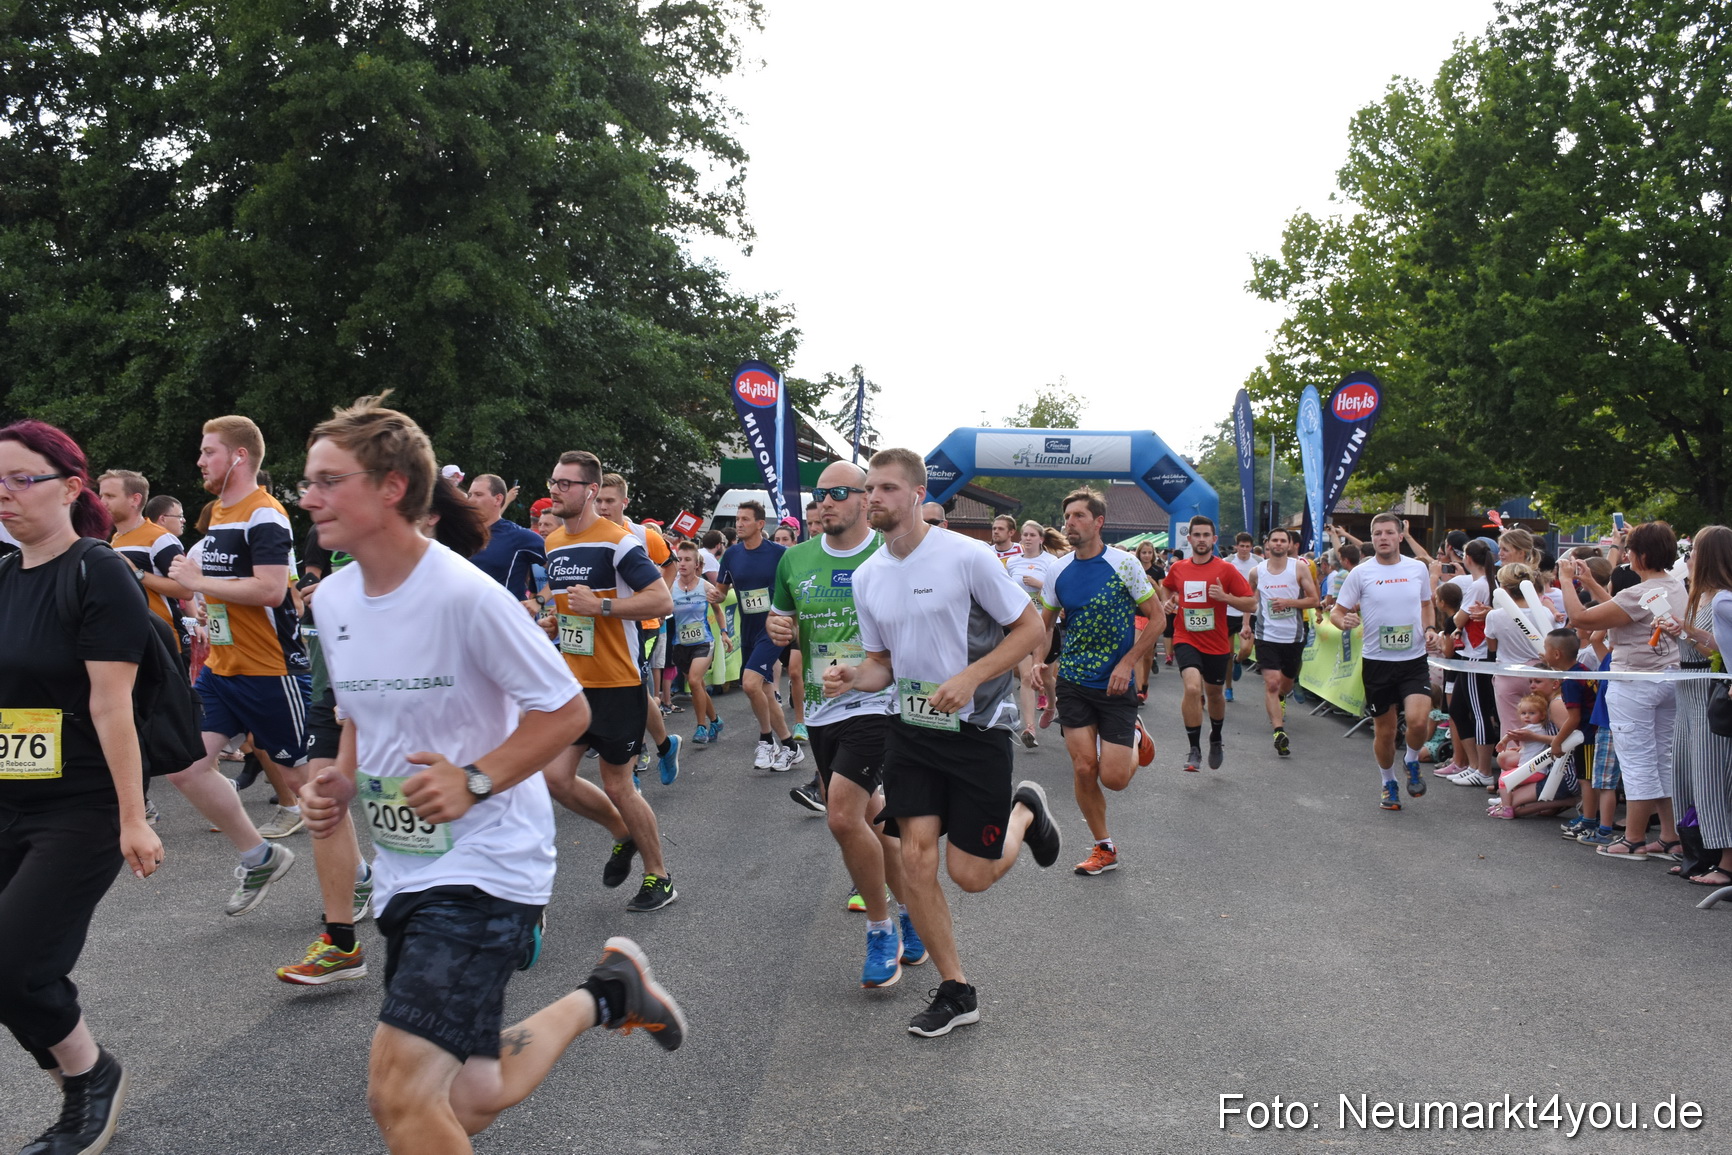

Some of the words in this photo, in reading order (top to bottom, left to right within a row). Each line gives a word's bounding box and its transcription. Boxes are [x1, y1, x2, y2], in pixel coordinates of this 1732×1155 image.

[1336, 391, 1375, 413] Hervis
[1034, 453, 1093, 465] firmenlauf
[553, 564, 593, 576] Fischer
[745, 597, 763, 608] 811
[799, 607, 838, 620] Gesunde
[812, 619, 845, 629] laufen
[1189, 616, 1208, 626] 539
[561, 627, 583, 644] 775
[681, 628, 702, 640] 2108
[1383, 633, 1410, 644] 1148
